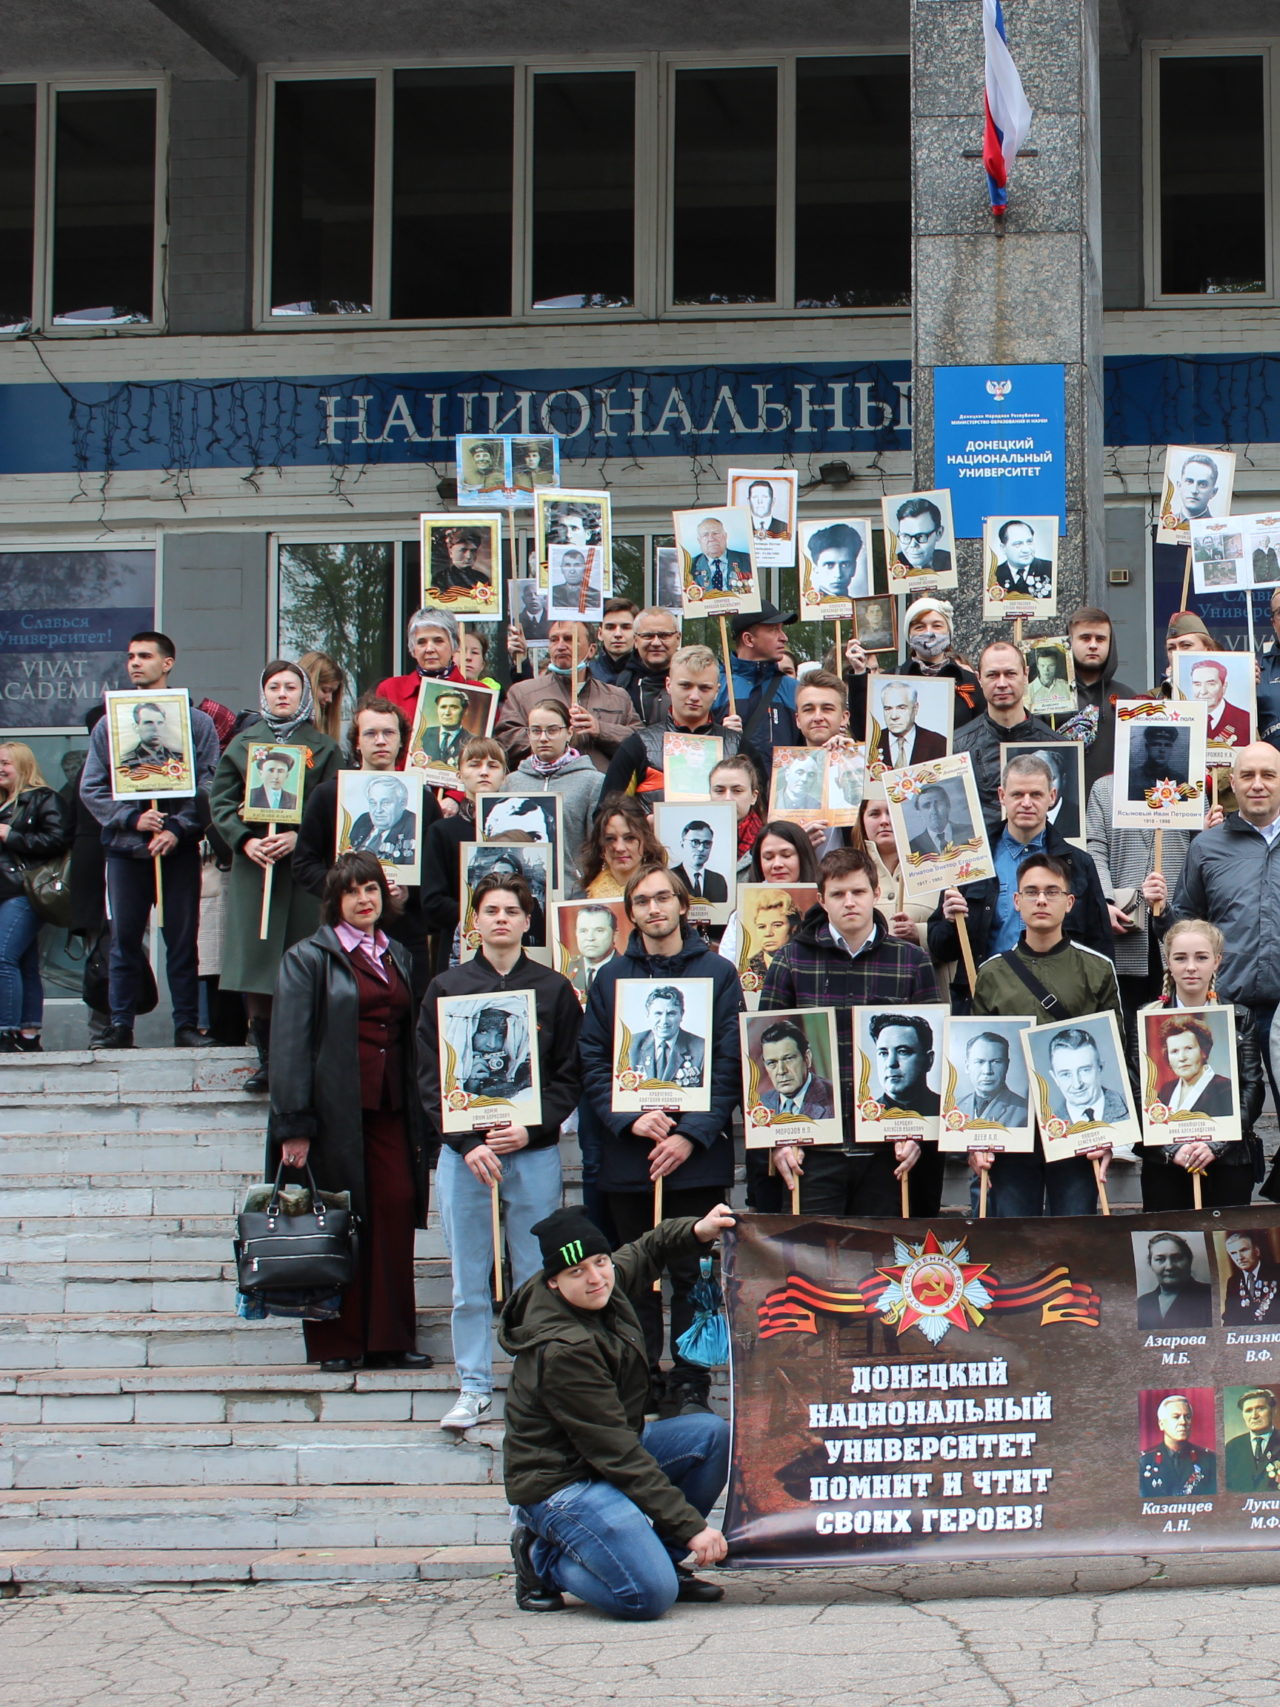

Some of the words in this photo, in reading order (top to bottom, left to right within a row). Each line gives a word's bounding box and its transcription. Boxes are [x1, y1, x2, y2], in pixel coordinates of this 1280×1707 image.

[966, 437, 1034, 452] ДОНЕЦКИЙ
[947, 450, 1052, 466] НАЦИОНАЛЬНЫЙ
[959, 466, 1041, 478] УНИВЕРСИТЕТ
[21, 614, 90, 630] Славься
[22, 660, 88, 678] VIVAT
[0, 681, 119, 701] CADEMIA!
[904, 1255, 957, 1309] ОТЕЧЕСТВЕННАЯ
[1144, 1334, 1206, 1349] Азарова
[1161, 1352, 1191, 1365] М.Б.
[1245, 1349, 1273, 1362] В.Ф.
[851, 1357, 1008, 1394] ДОНЕЦКИЙ
[808, 1391, 1052, 1430] НАЦИОНАЛЬНЫЙ
[824, 1432, 1037, 1464] УНИВЕРСИТЕТ
[809, 1473, 933, 1501] ПОМНИТ
[942, 1472, 963, 1496] И
[972, 1468, 1053, 1496] ЧТИТ
[1142, 1502, 1213, 1516] Казанцев
[815, 1509, 912, 1534] СВОИХ
[921, 1504, 1043, 1533] ГЕРОЕВ!
[1163, 1519, 1191, 1533] А.Н.
